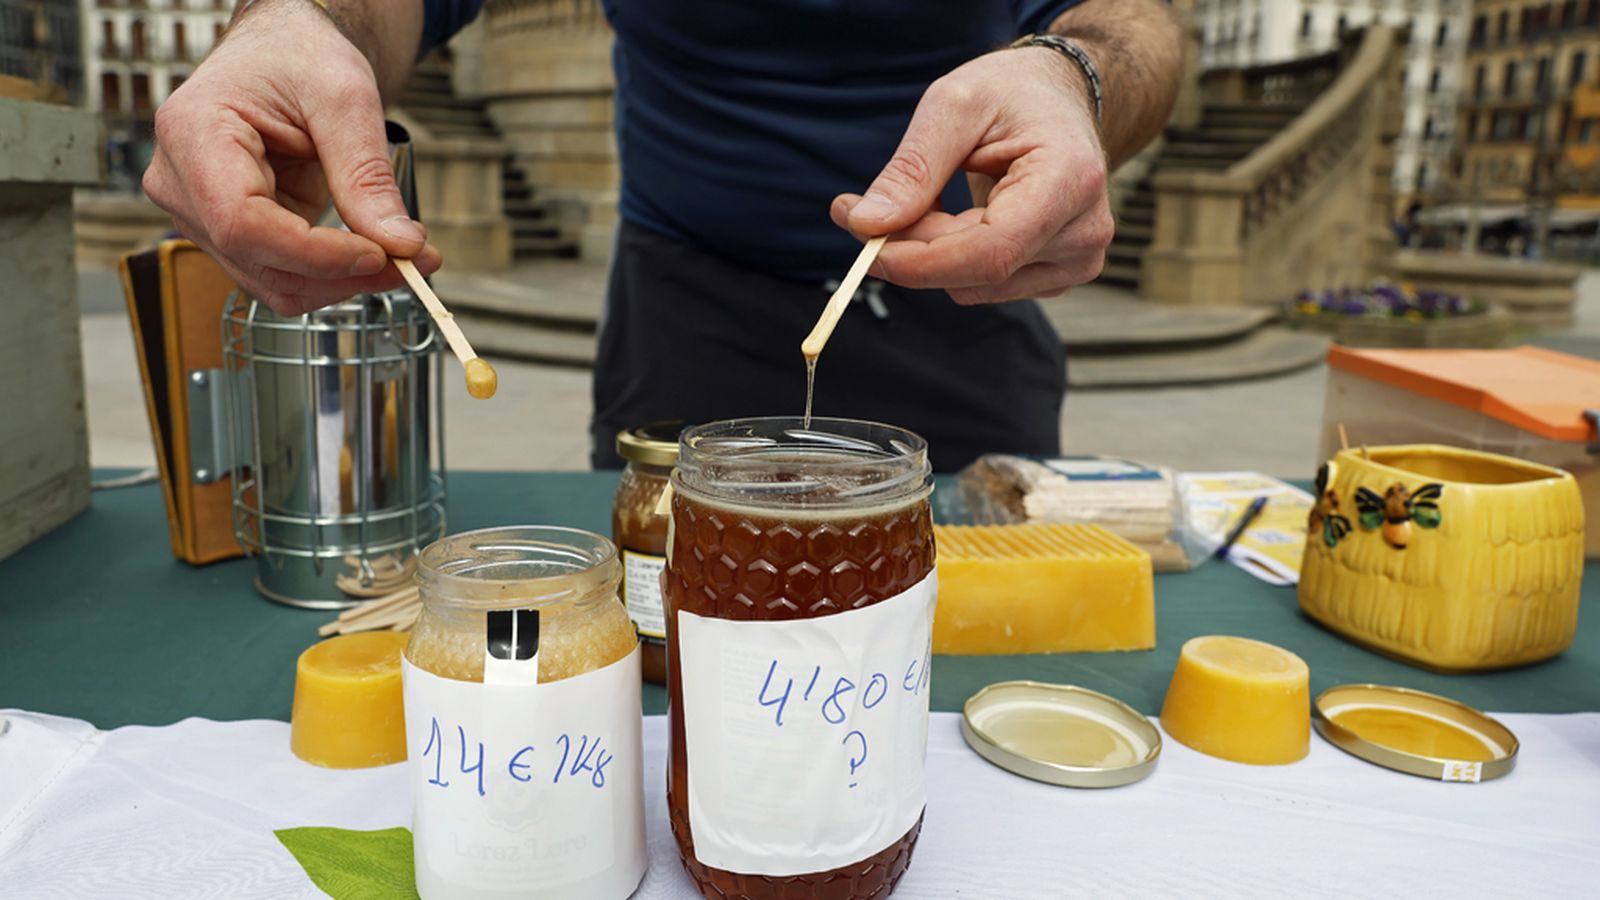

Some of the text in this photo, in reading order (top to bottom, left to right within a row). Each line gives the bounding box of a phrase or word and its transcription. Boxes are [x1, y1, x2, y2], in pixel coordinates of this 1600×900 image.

[423, 717, 486, 796] 14
[508, 746, 535, 782] €
[842, 730, 868, 788] ?
